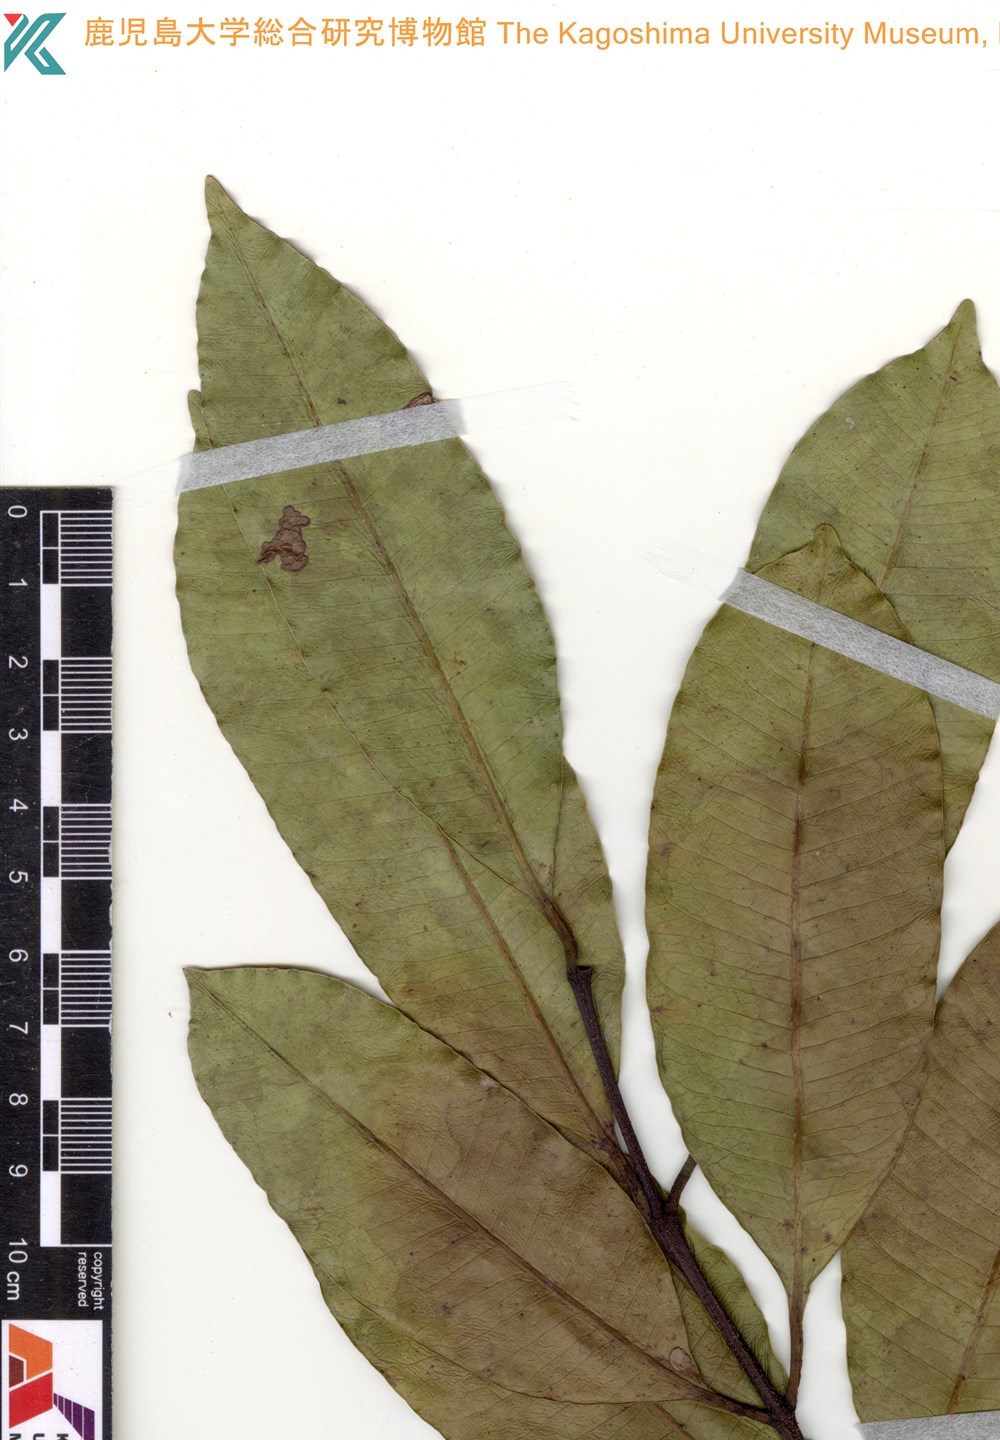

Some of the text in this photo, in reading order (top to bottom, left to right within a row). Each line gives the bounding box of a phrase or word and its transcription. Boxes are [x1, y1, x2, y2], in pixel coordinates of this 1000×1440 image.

[7, 505, 28, 519] 0
[8, 578, 28, 586] 1
[8, 655, 29, 669] 2
[8, 727, 29, 741] 3
[9, 798, 29, 813] 4
[8, 870, 29, 884] 5
[8, 948, 29, 963] 6
[9, 1021, 29, 1035] 7
[8, 1092, 29, 1106] 8
[8, 1164, 29, 1178] 9
[6, 1237, 29, 1301] 10 cm
[77, 1252, 89, 1307] reserved
[91, 1251, 105, 1311] copyright
